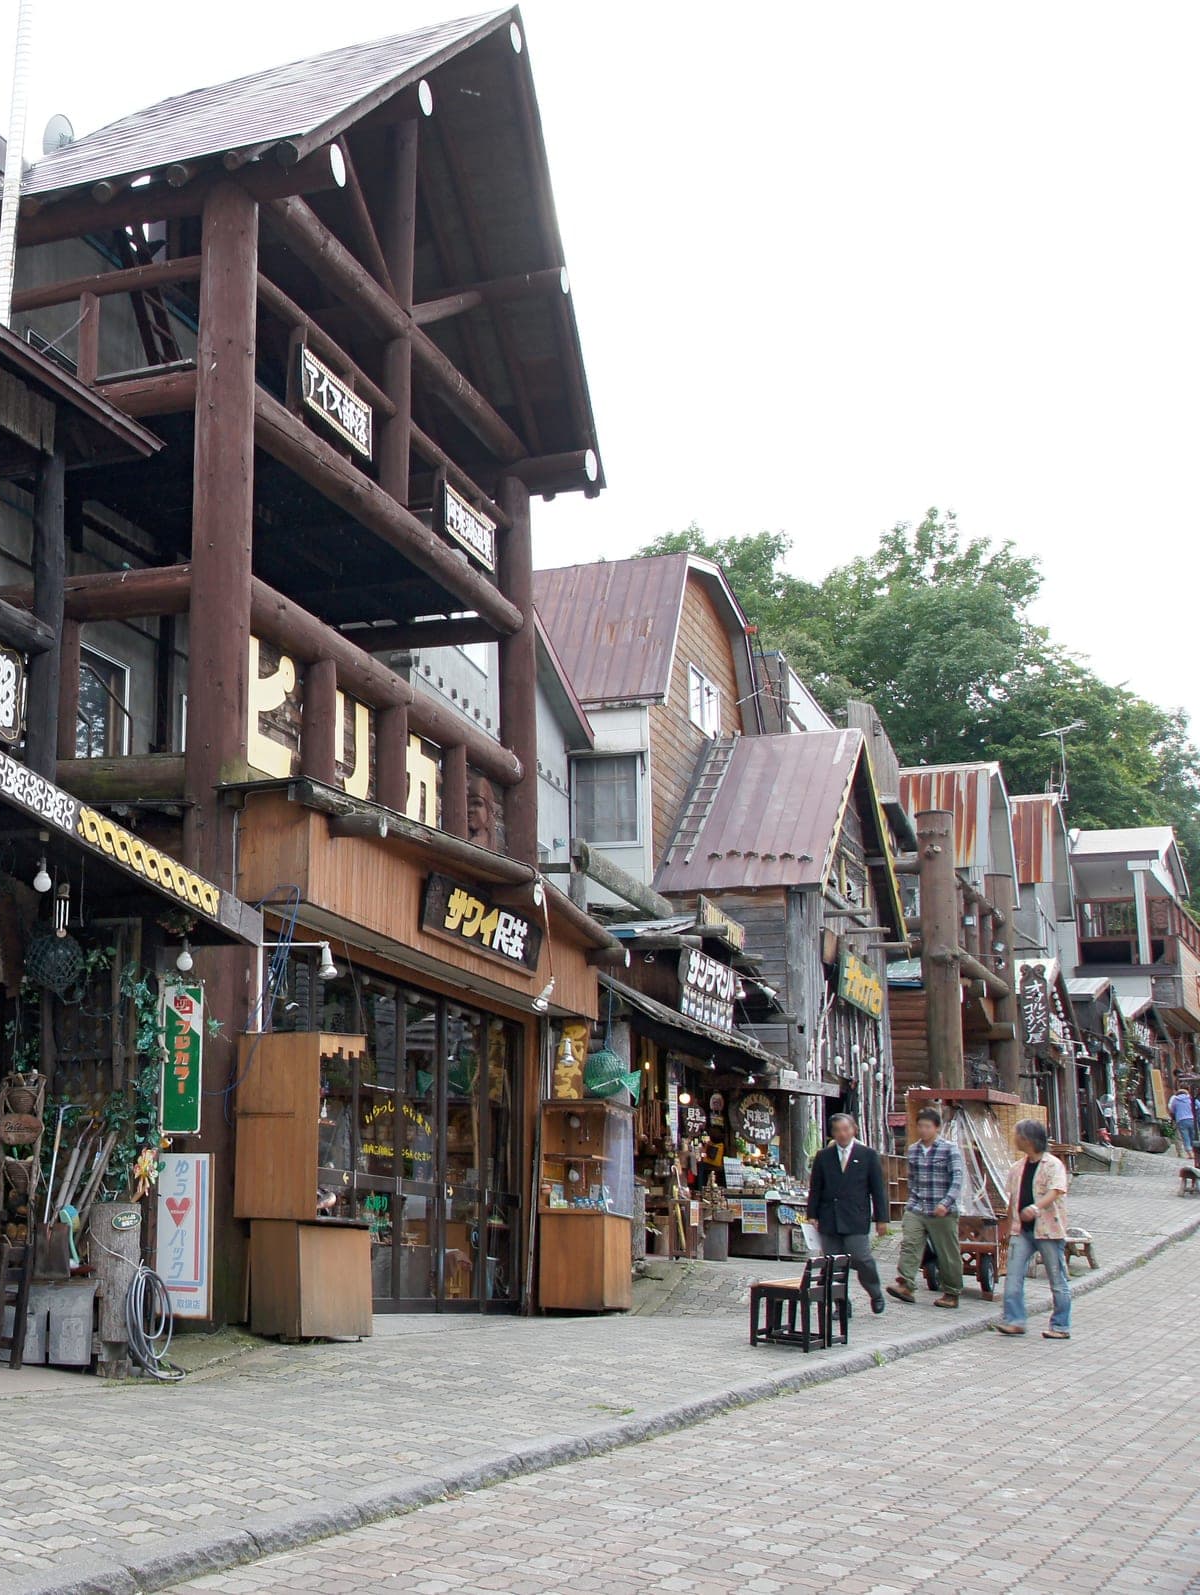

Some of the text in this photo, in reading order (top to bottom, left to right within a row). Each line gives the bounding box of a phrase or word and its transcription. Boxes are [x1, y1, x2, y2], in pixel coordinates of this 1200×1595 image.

[305, 360, 368, 444] アイヌ部落
[173, 1020, 191, 1095] フジカラー
[174, 1159, 190, 1196] ゆう
[168, 1229, 187, 1279] パック
